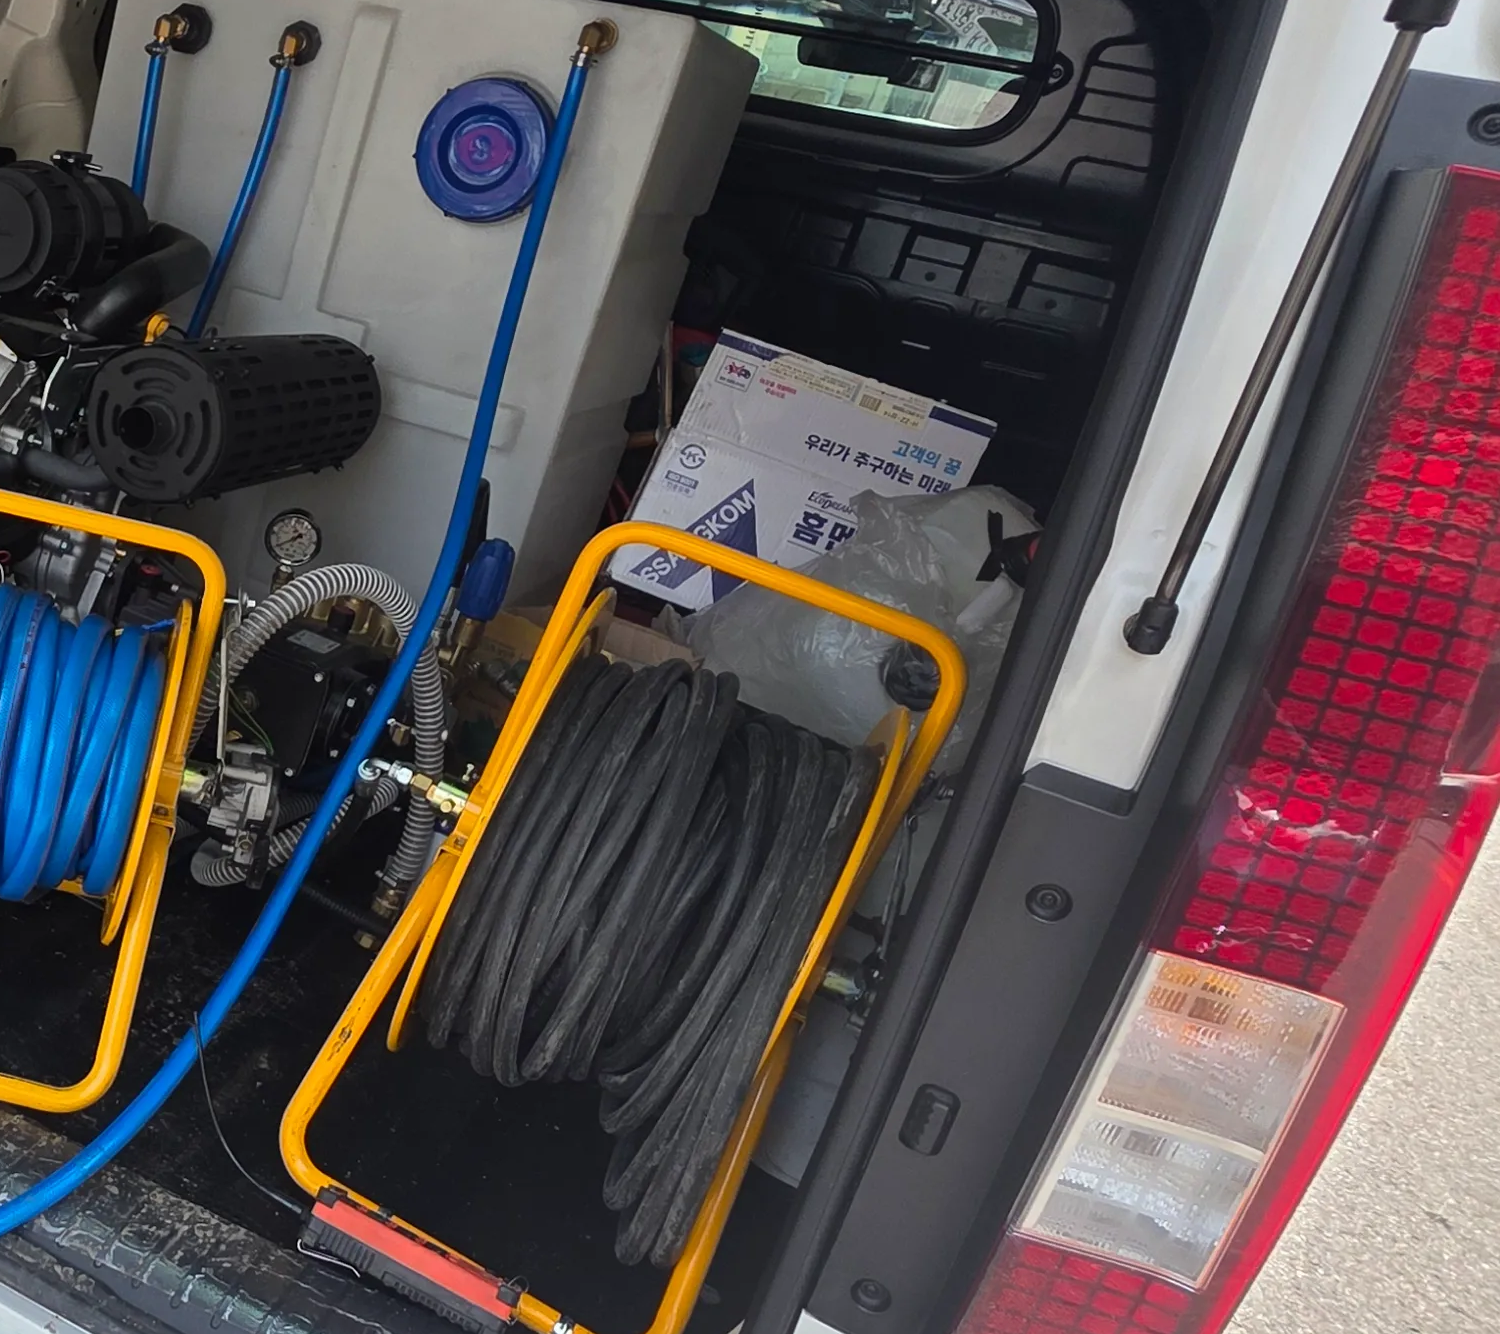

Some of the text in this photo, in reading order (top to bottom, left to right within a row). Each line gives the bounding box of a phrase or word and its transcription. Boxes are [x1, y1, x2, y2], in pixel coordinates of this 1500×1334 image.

[804, 433, 953, 494] 우리가 추구하는 미래
[892, 440, 963, 477] 고객의 꿈
[640, 489, 756, 584] SSAGKOM
